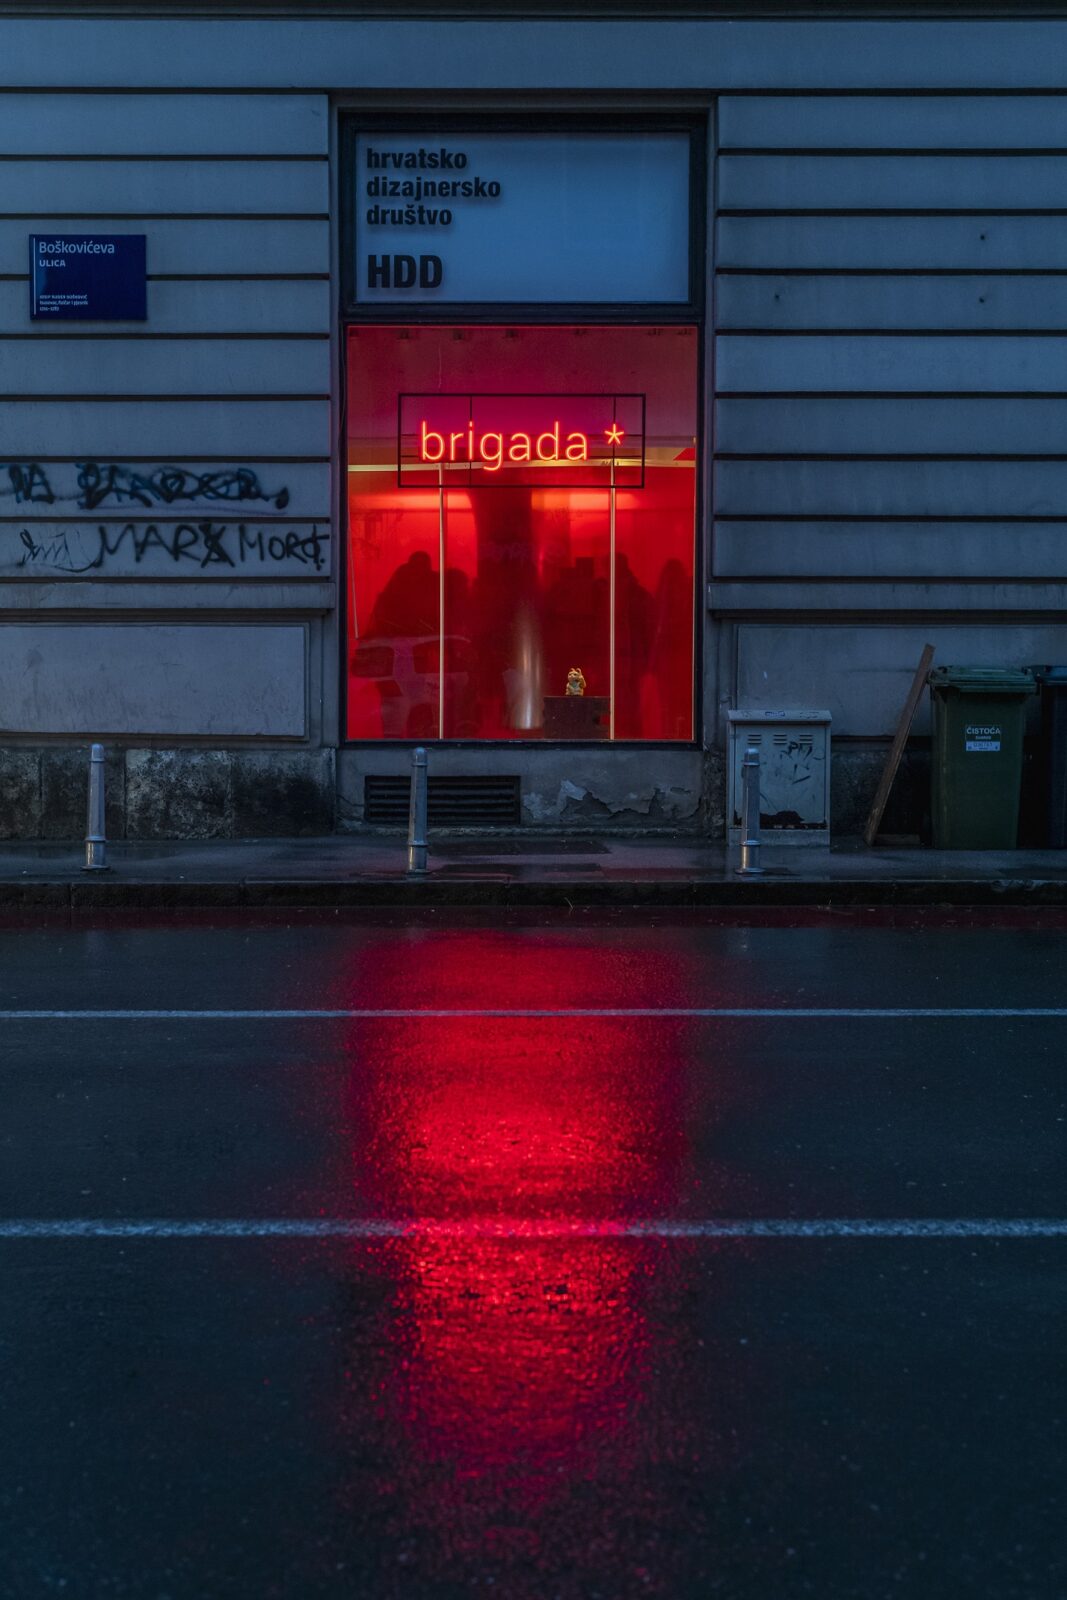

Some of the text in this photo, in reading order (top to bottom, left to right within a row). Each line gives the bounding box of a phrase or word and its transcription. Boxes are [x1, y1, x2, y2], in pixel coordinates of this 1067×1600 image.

[367, 148, 467, 169] hrvatsko
[367, 176, 501, 201] dizajnersko
[367, 204, 452, 225] društvo
[39, 240, 115, 254] Boškovićeva
[39, 259, 66, 268] ULICA
[368, 254, 443, 288] HDD
[421, 420, 590, 472] brigada
